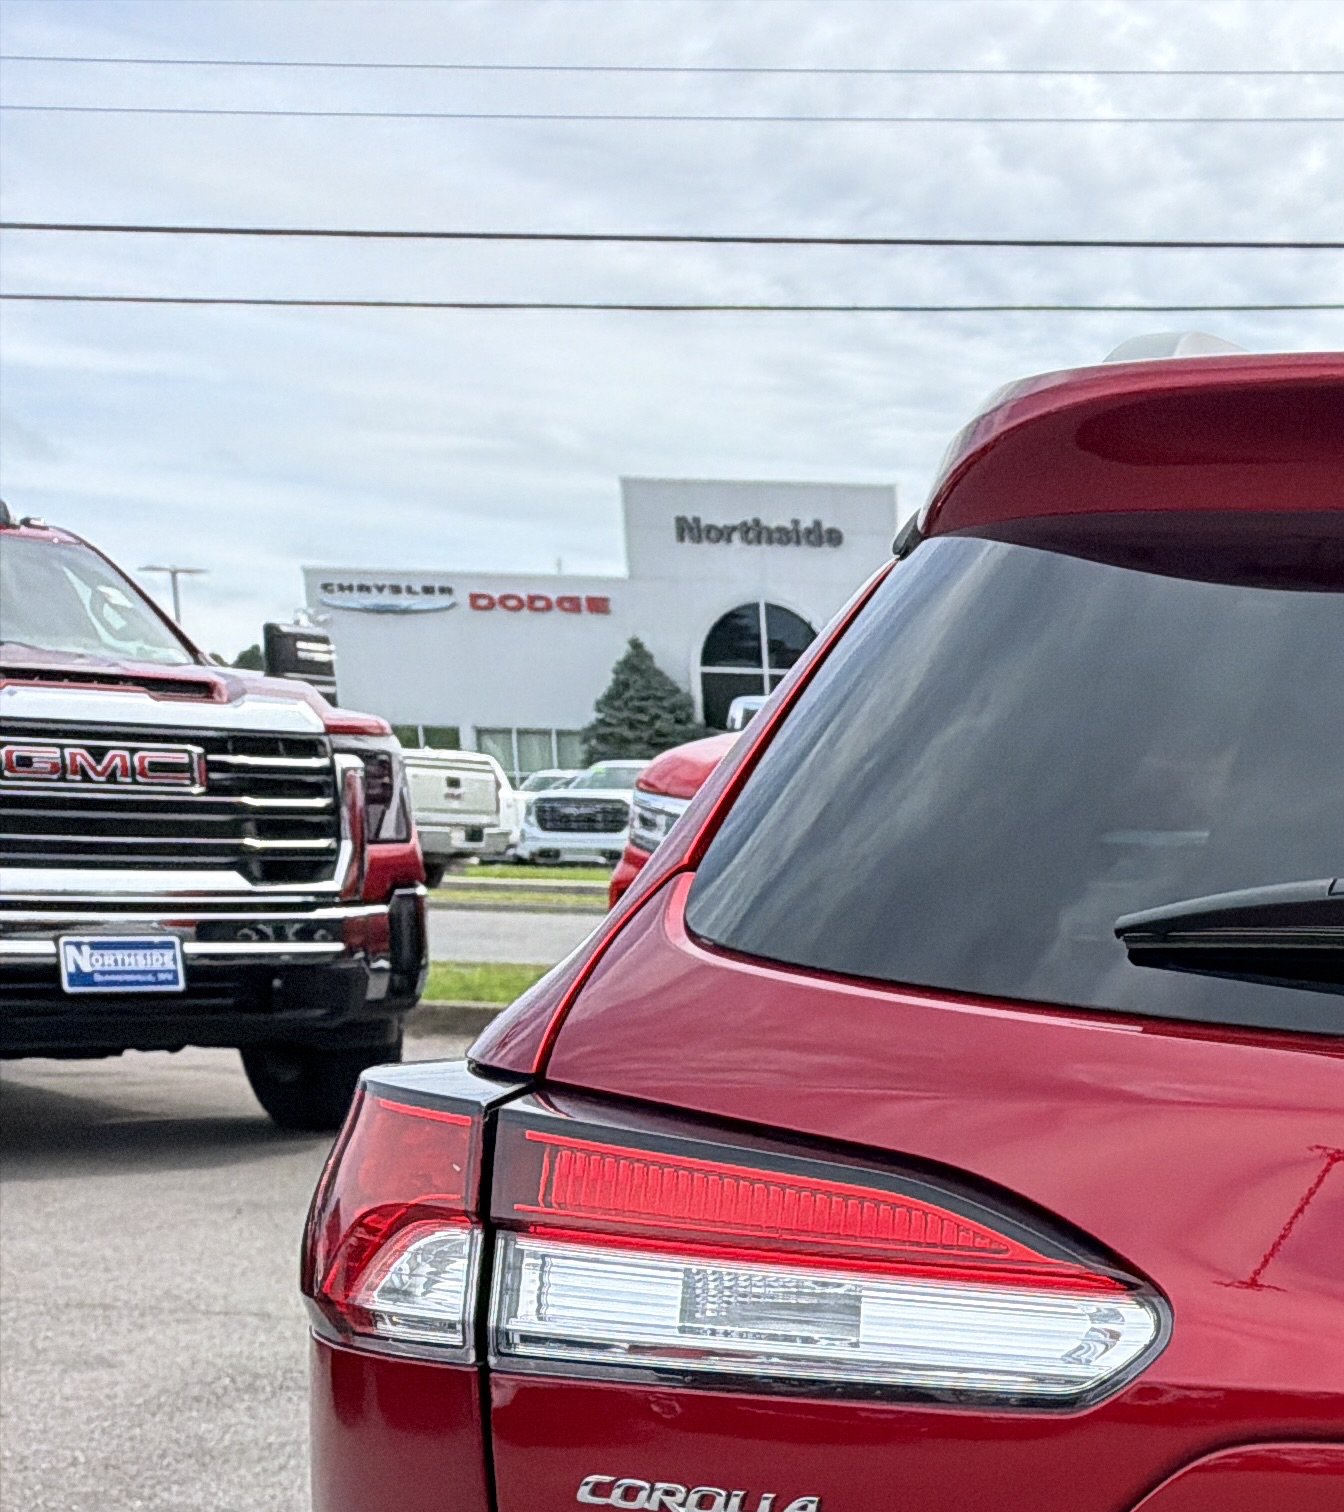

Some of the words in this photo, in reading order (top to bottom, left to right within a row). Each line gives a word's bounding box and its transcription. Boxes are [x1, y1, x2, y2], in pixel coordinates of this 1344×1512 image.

[674, 515, 843, 547] Northside
[321, 582, 454, 596] CHRYSLER
[469, 592, 611, 615] DODGE
[1, 745, 191, 785] GMC
